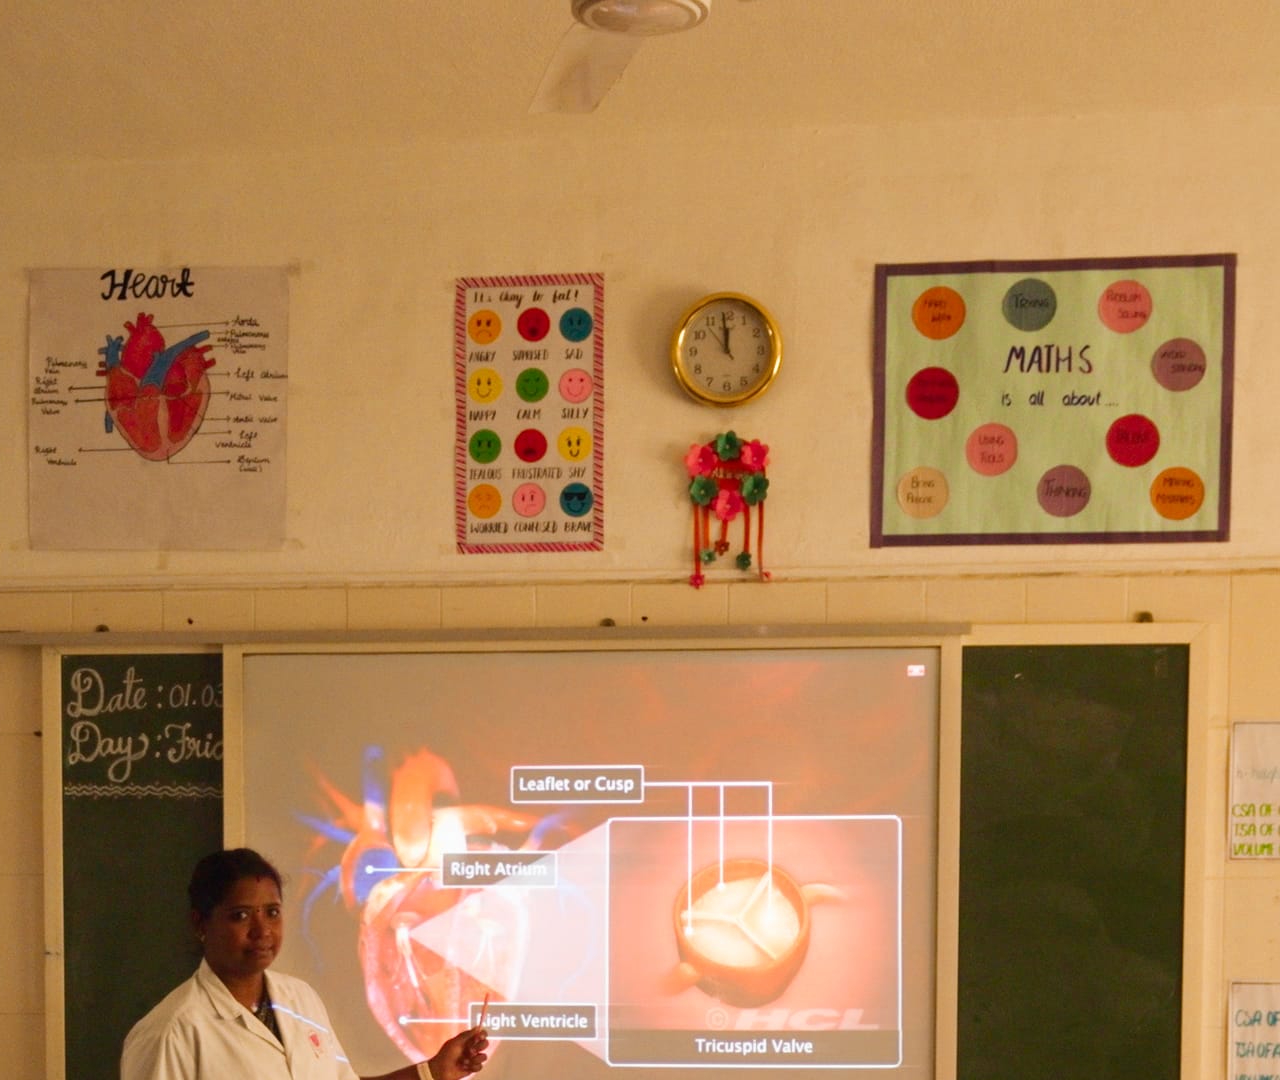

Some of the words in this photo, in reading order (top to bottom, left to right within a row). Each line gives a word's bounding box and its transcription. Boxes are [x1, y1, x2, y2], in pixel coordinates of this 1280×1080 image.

[100, 268, 195, 300] Heart
[564, 349, 583, 361] SAD
[1003, 344, 1093, 375] MATHS
[1002, 393, 1012, 407] is
[1029, 392, 1045, 407] all
[516, 408, 542, 420] CALM
[561, 407, 589, 419] SILLY
[568, 466, 587, 478] SHY
[564, 519, 594, 533] BRAVE
[67, 666, 148, 718] Date
[68, 721, 149, 783] Day
[519, 776, 570, 792] Leaflet
[574, 779, 591, 792] or
[595, 776, 635, 794] Cusp
[450, 861, 490, 879] Right
[494, 861, 548, 876] Atrium
[520, 1011, 589, 1029] Ventricle
[695, 1038, 768, 1056] Tricuspid
[772, 1038, 814, 1054] Valve
